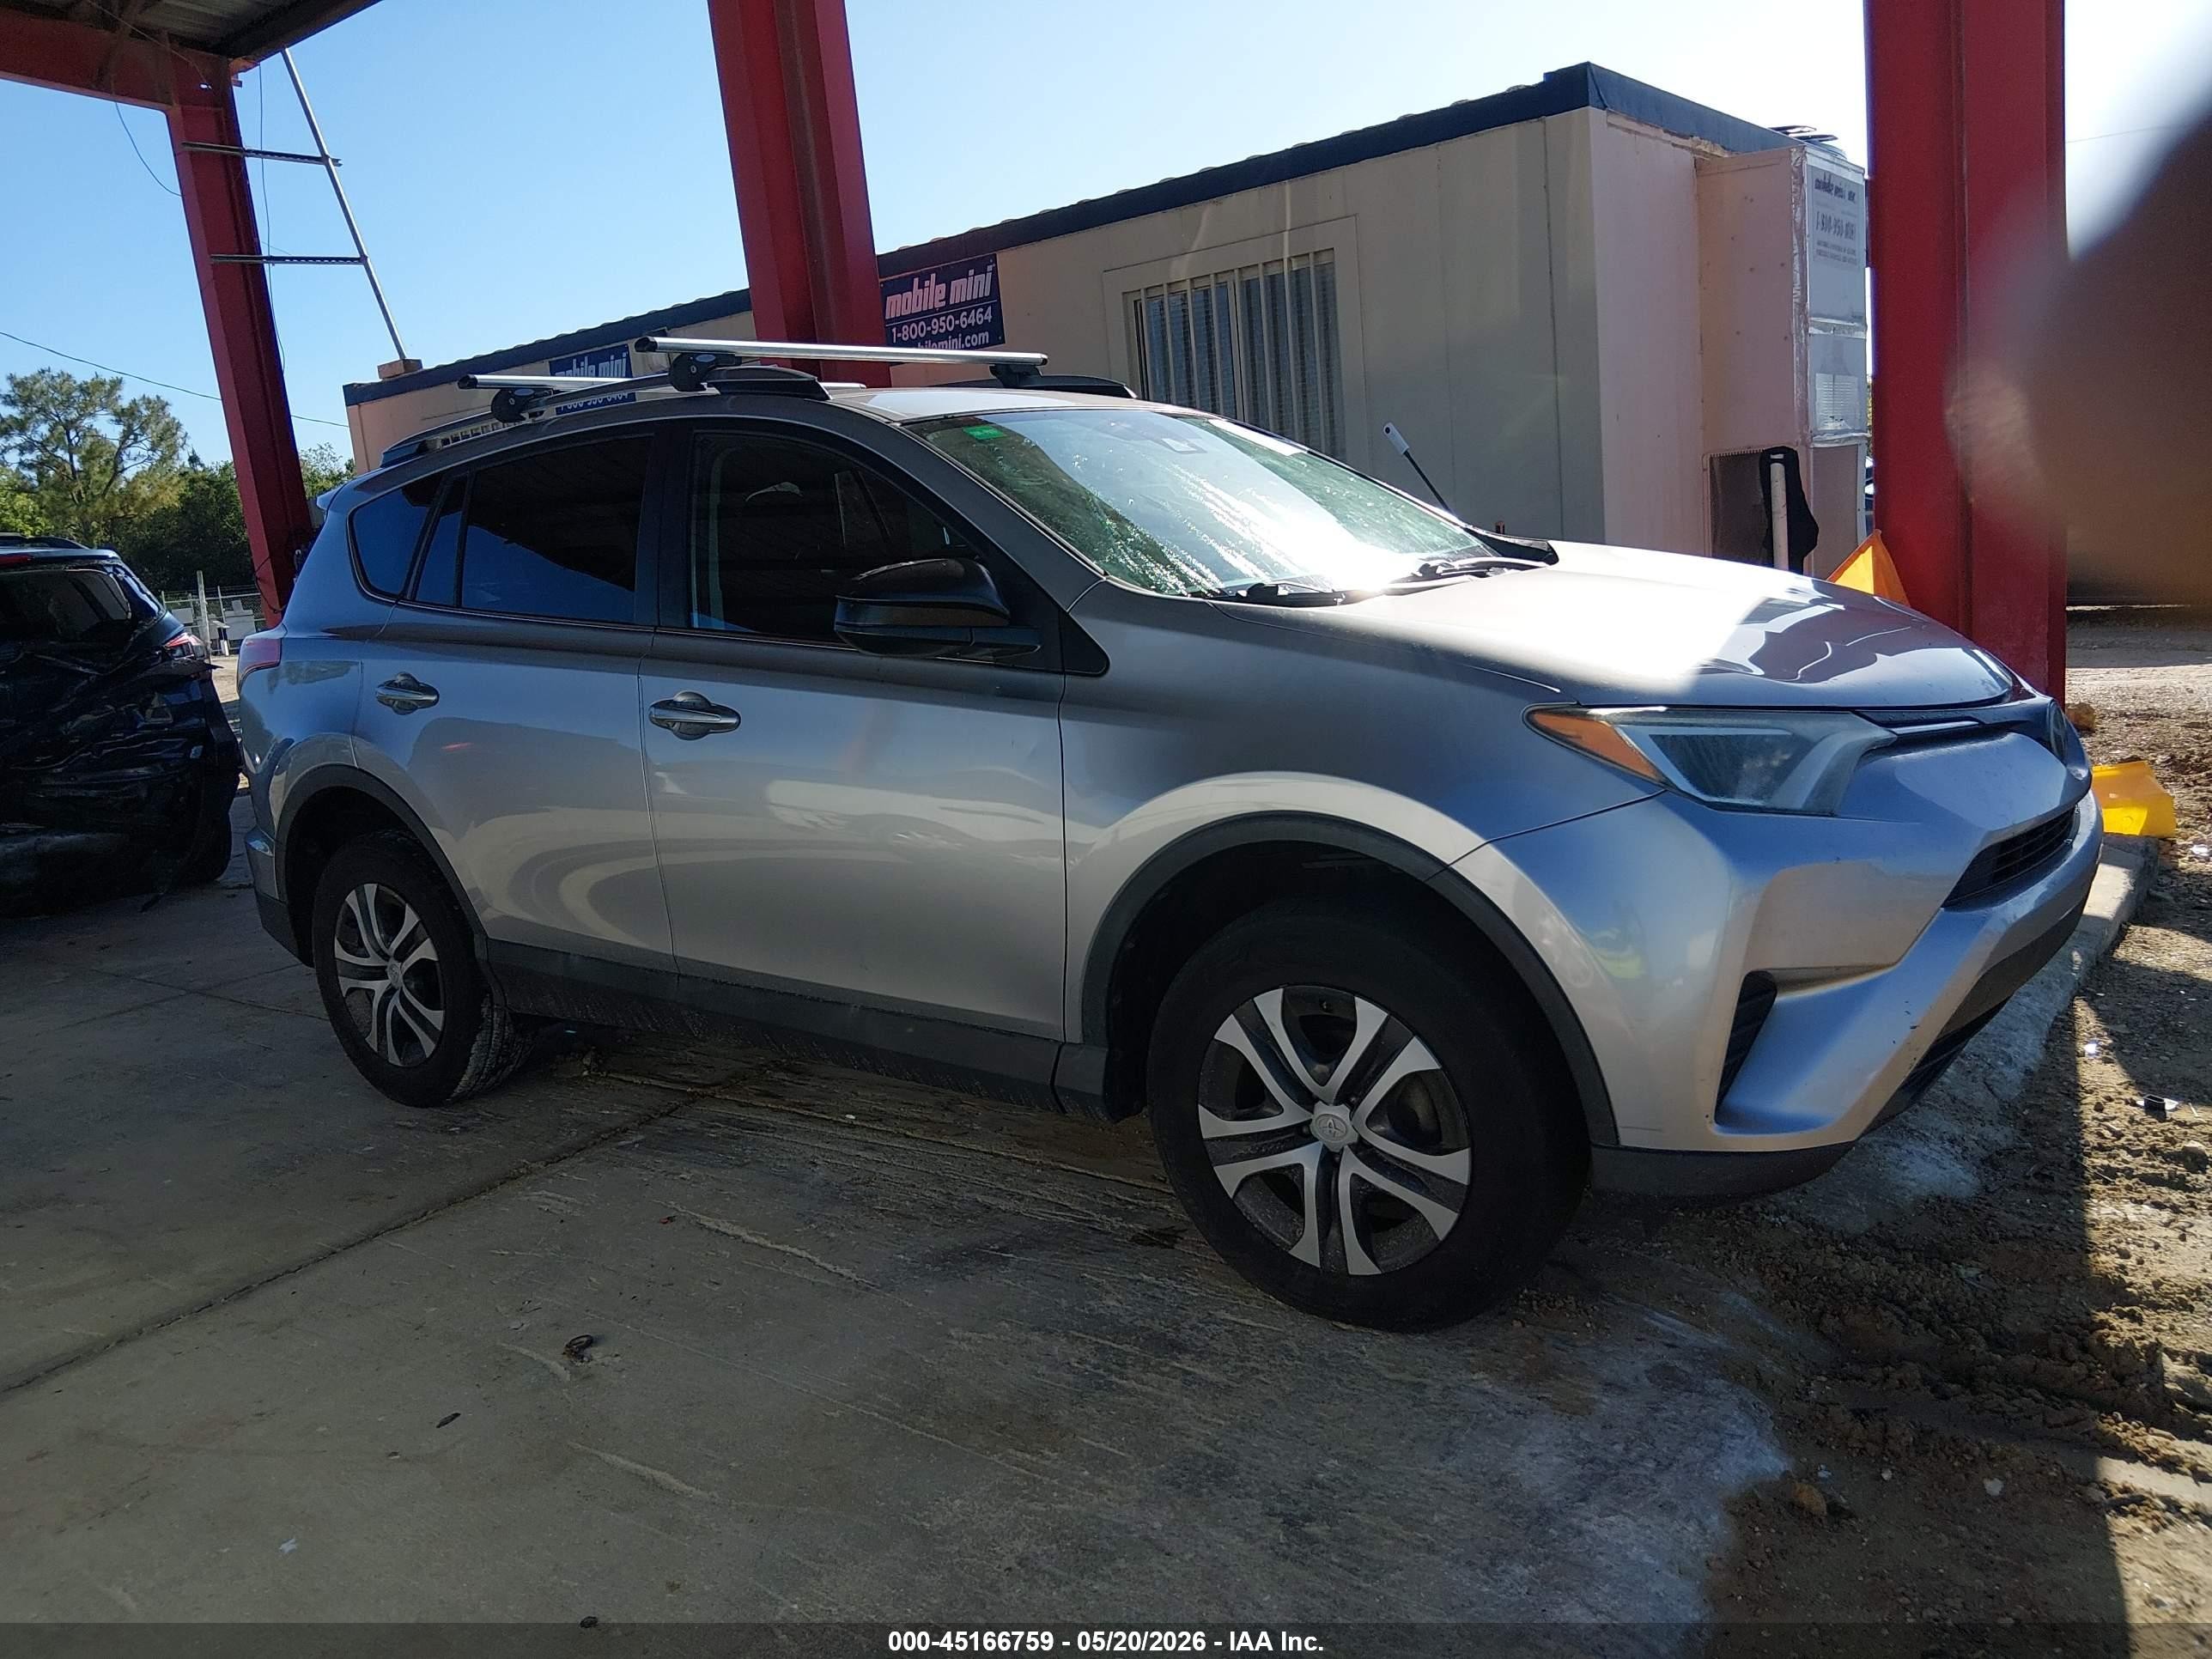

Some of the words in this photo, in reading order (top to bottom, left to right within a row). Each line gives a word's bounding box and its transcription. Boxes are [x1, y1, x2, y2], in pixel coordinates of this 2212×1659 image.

[885, 273, 946, 319] mobile
[950, 265, 993, 305] mini
[891, 306, 993, 343] 1-800-950-6464
